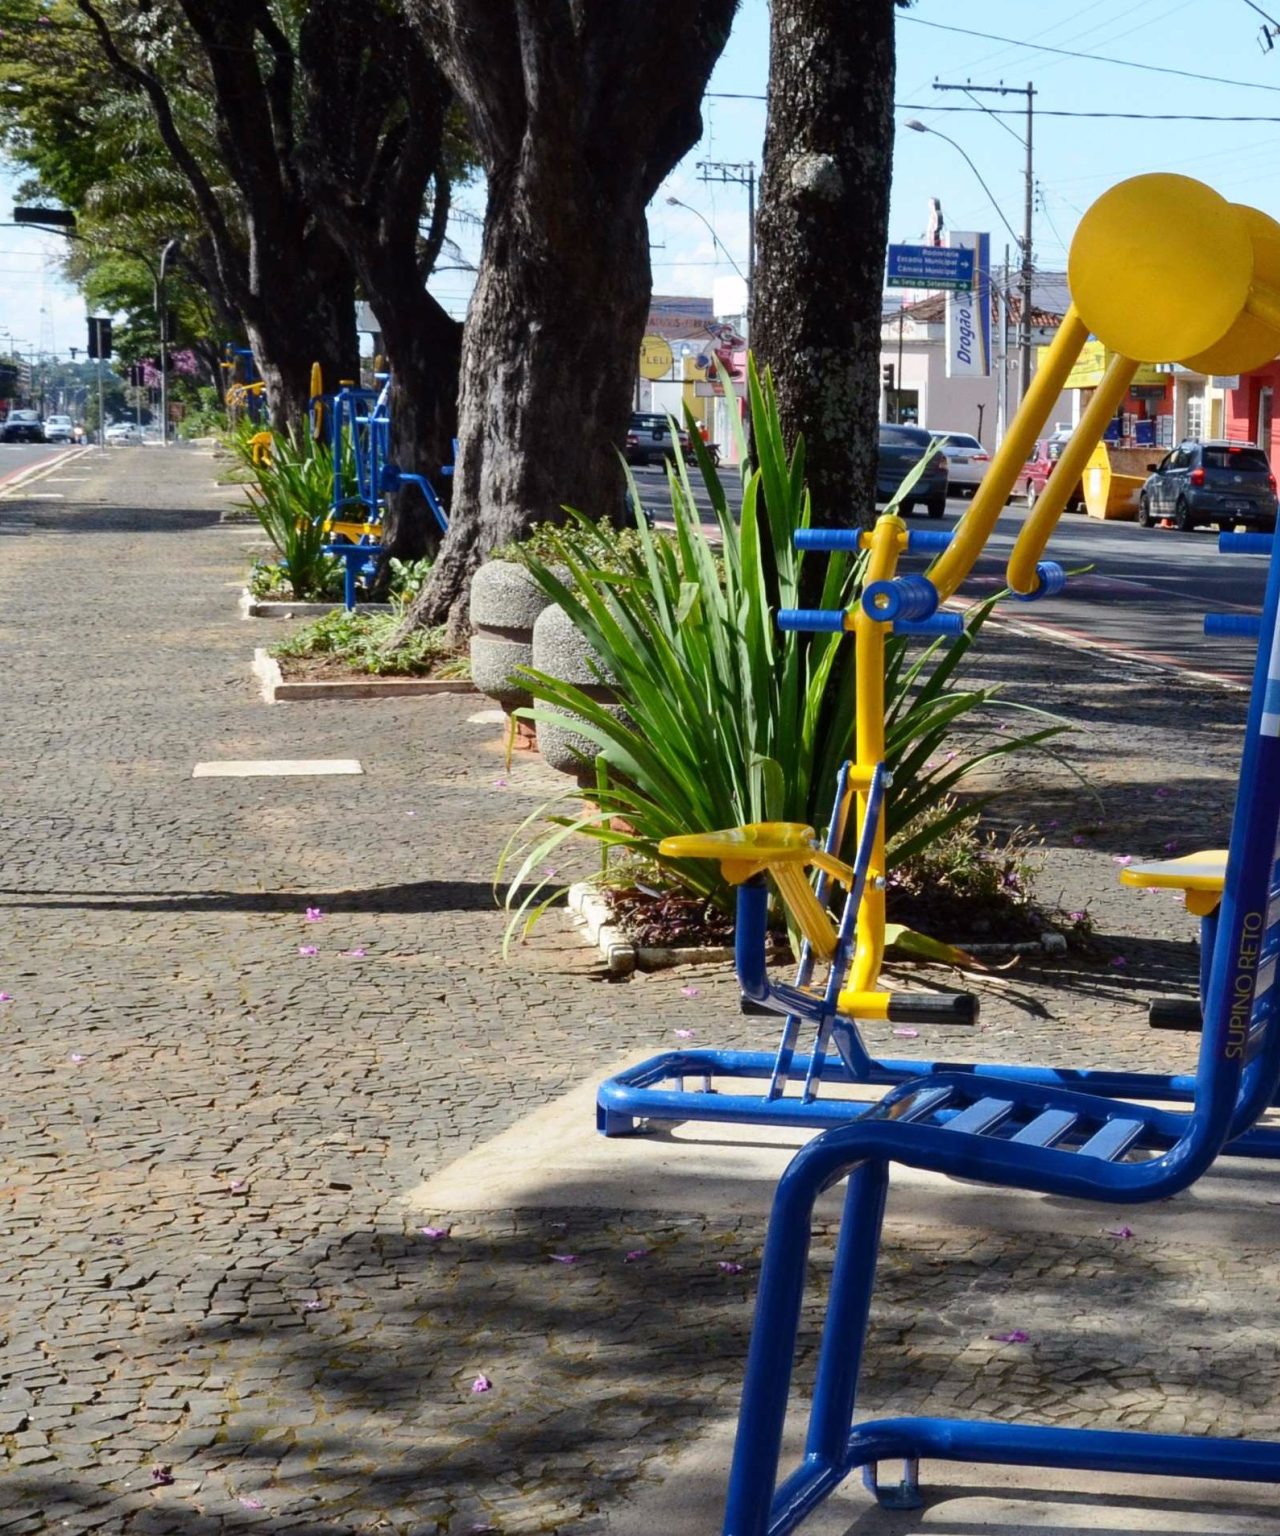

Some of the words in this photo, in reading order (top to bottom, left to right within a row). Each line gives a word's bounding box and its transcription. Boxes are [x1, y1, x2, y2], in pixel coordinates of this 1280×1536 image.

[956, 309, 975, 365] Drogão
[1237, 911, 1263, 970] RETO
[1225, 974, 1253, 1059] SUPINO
